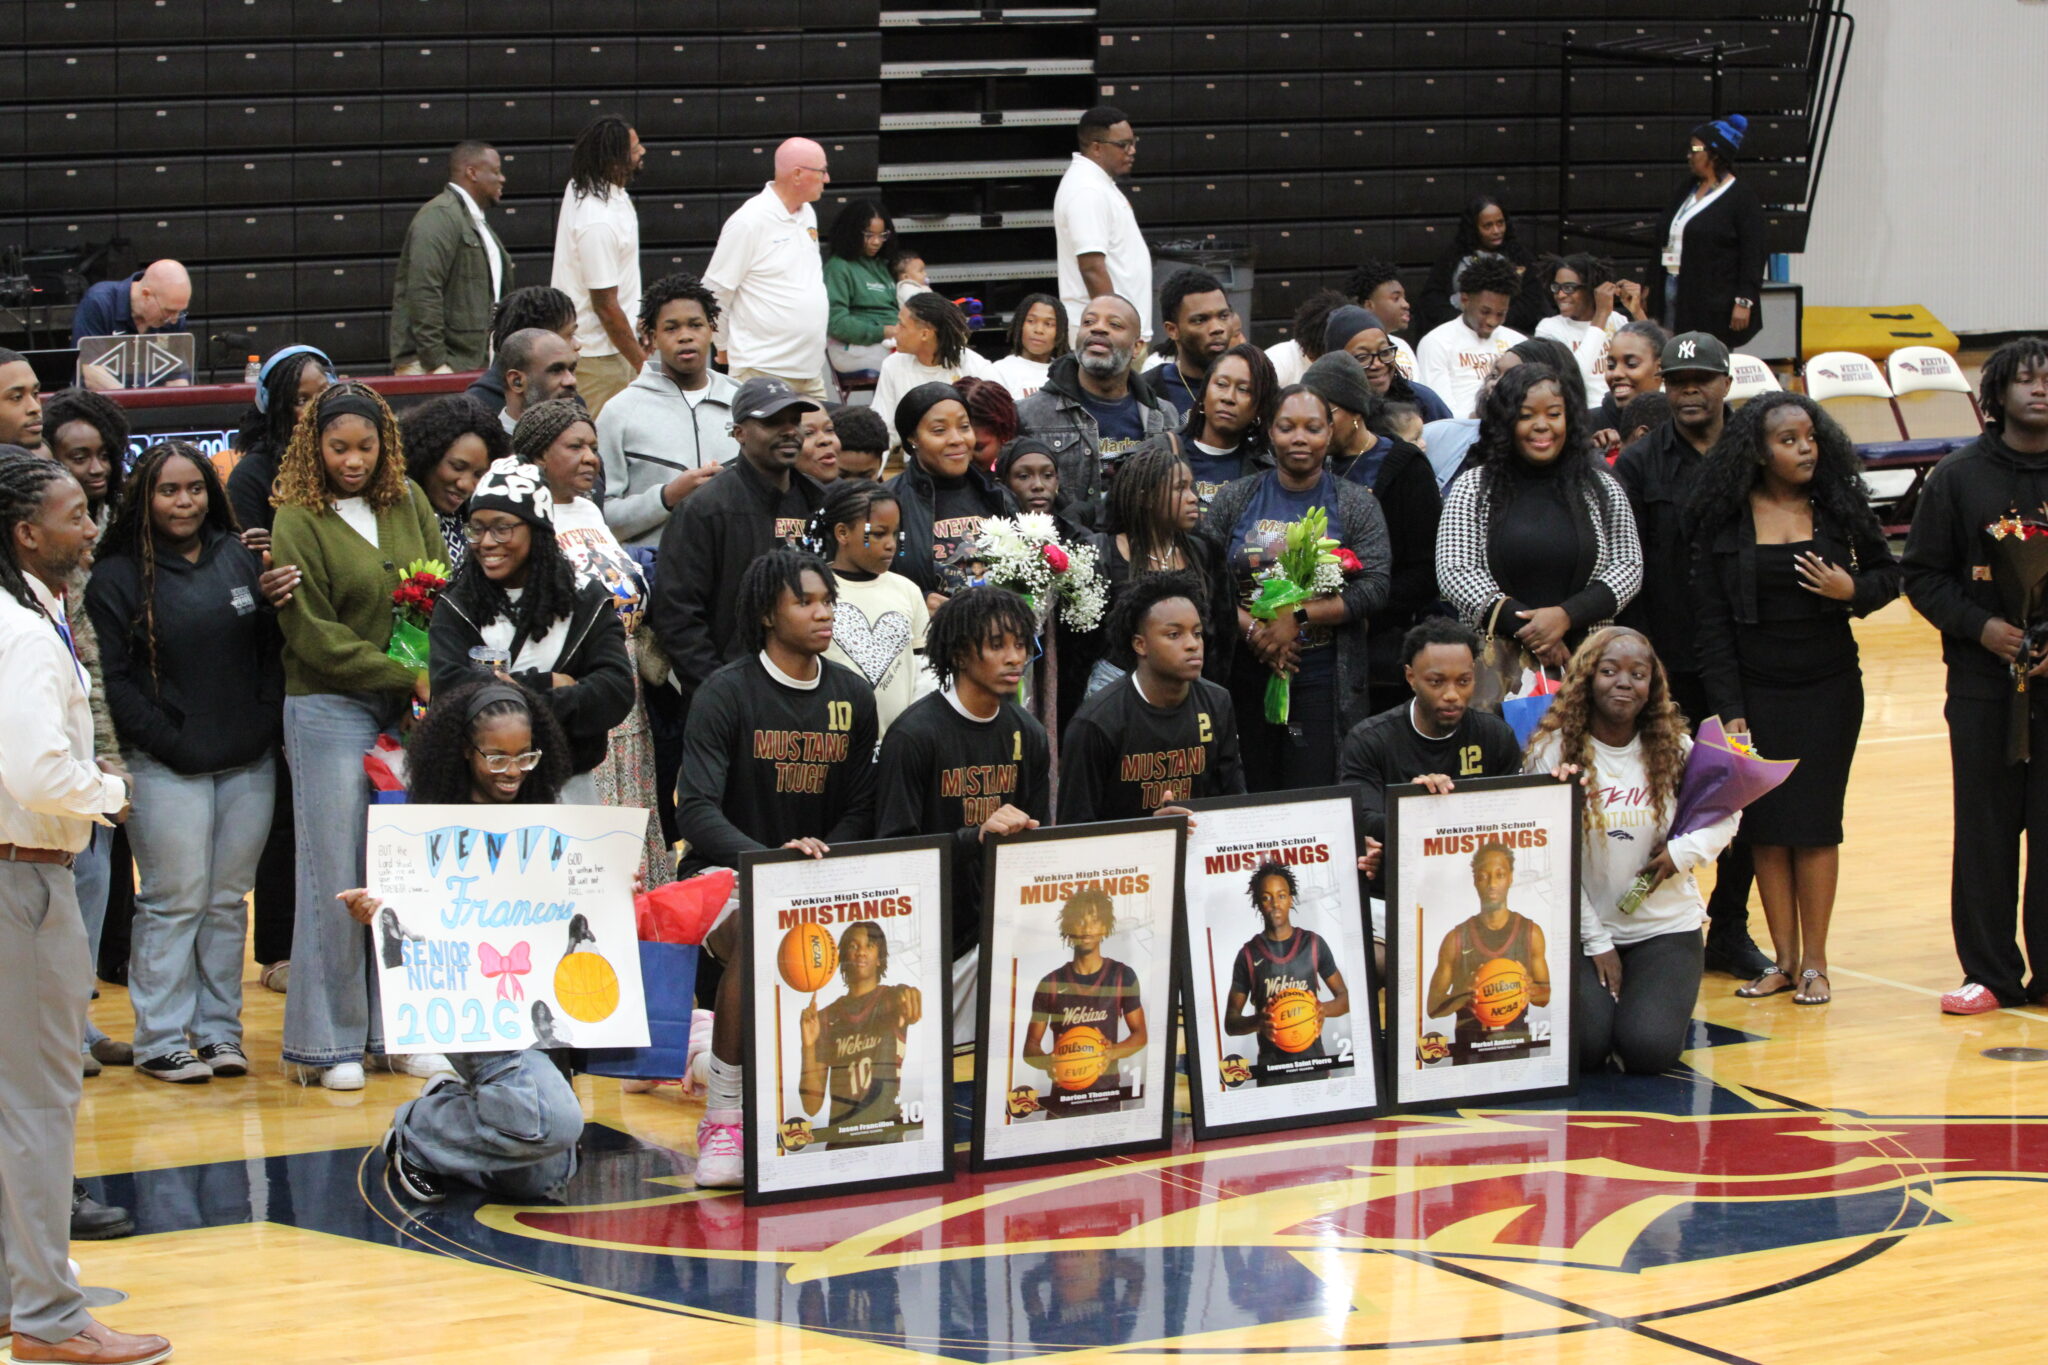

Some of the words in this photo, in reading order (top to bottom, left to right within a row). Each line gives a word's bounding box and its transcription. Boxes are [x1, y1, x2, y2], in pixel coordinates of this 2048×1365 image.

[1734, 365, 1762, 374] WEKIVA
[1840, 363, 1869, 373] WEKIVA
[1920, 357, 1948, 367] WEKIVA
[555, 528, 608, 551] WEKIVA
[827, 700, 852, 731] 10
[1197, 713, 1213, 742] 2
[1012, 730, 1023, 761] 1
[1459, 745, 1483, 776] 12
[775, 762, 829, 793] TOUGH
[1436, 826, 1474, 835] Wekiva
[1476, 823, 1499, 832] High
[1501, 820, 1536, 830] School
[428, 829, 562, 866] KENIA
[1216, 843, 1254, 853] Wekiva
[1256, 839, 1279, 850] High
[1281, 836, 1317, 846] School
[1423, 828, 1548, 857] MUSTANGS
[1204, 844, 1330, 875] MUSTANGS
[1034, 873, 1073, 883] Wekiva
[1075, 870, 1100, 880] High
[1102, 866, 1138, 877] School
[791, 896, 831, 907] Wekiva
[834, 891, 859, 903] High
[862, 888, 899, 899] School
[1020, 874, 1150, 905] MUSTANGS
[778, 896, 912, 930] MUSTANGS
[401, 939, 471, 967] SENIOR
[407, 964, 468, 991] NIGHT
[1264, 975, 1309, 998] Wekiva
[1483, 980, 1521, 997] Wilson
[1062, 1006, 1108, 1026] Wekiva
[1491, 1001, 1518, 1017] NCAA
[397, 997, 522, 1045] 2026
[1058, 1042, 1095, 1056] Wilson
[1294, 1060, 1311, 1068] Saint
[848, 1057, 872, 1095] 10
[1088, 1090, 1120, 1099] Thomas
